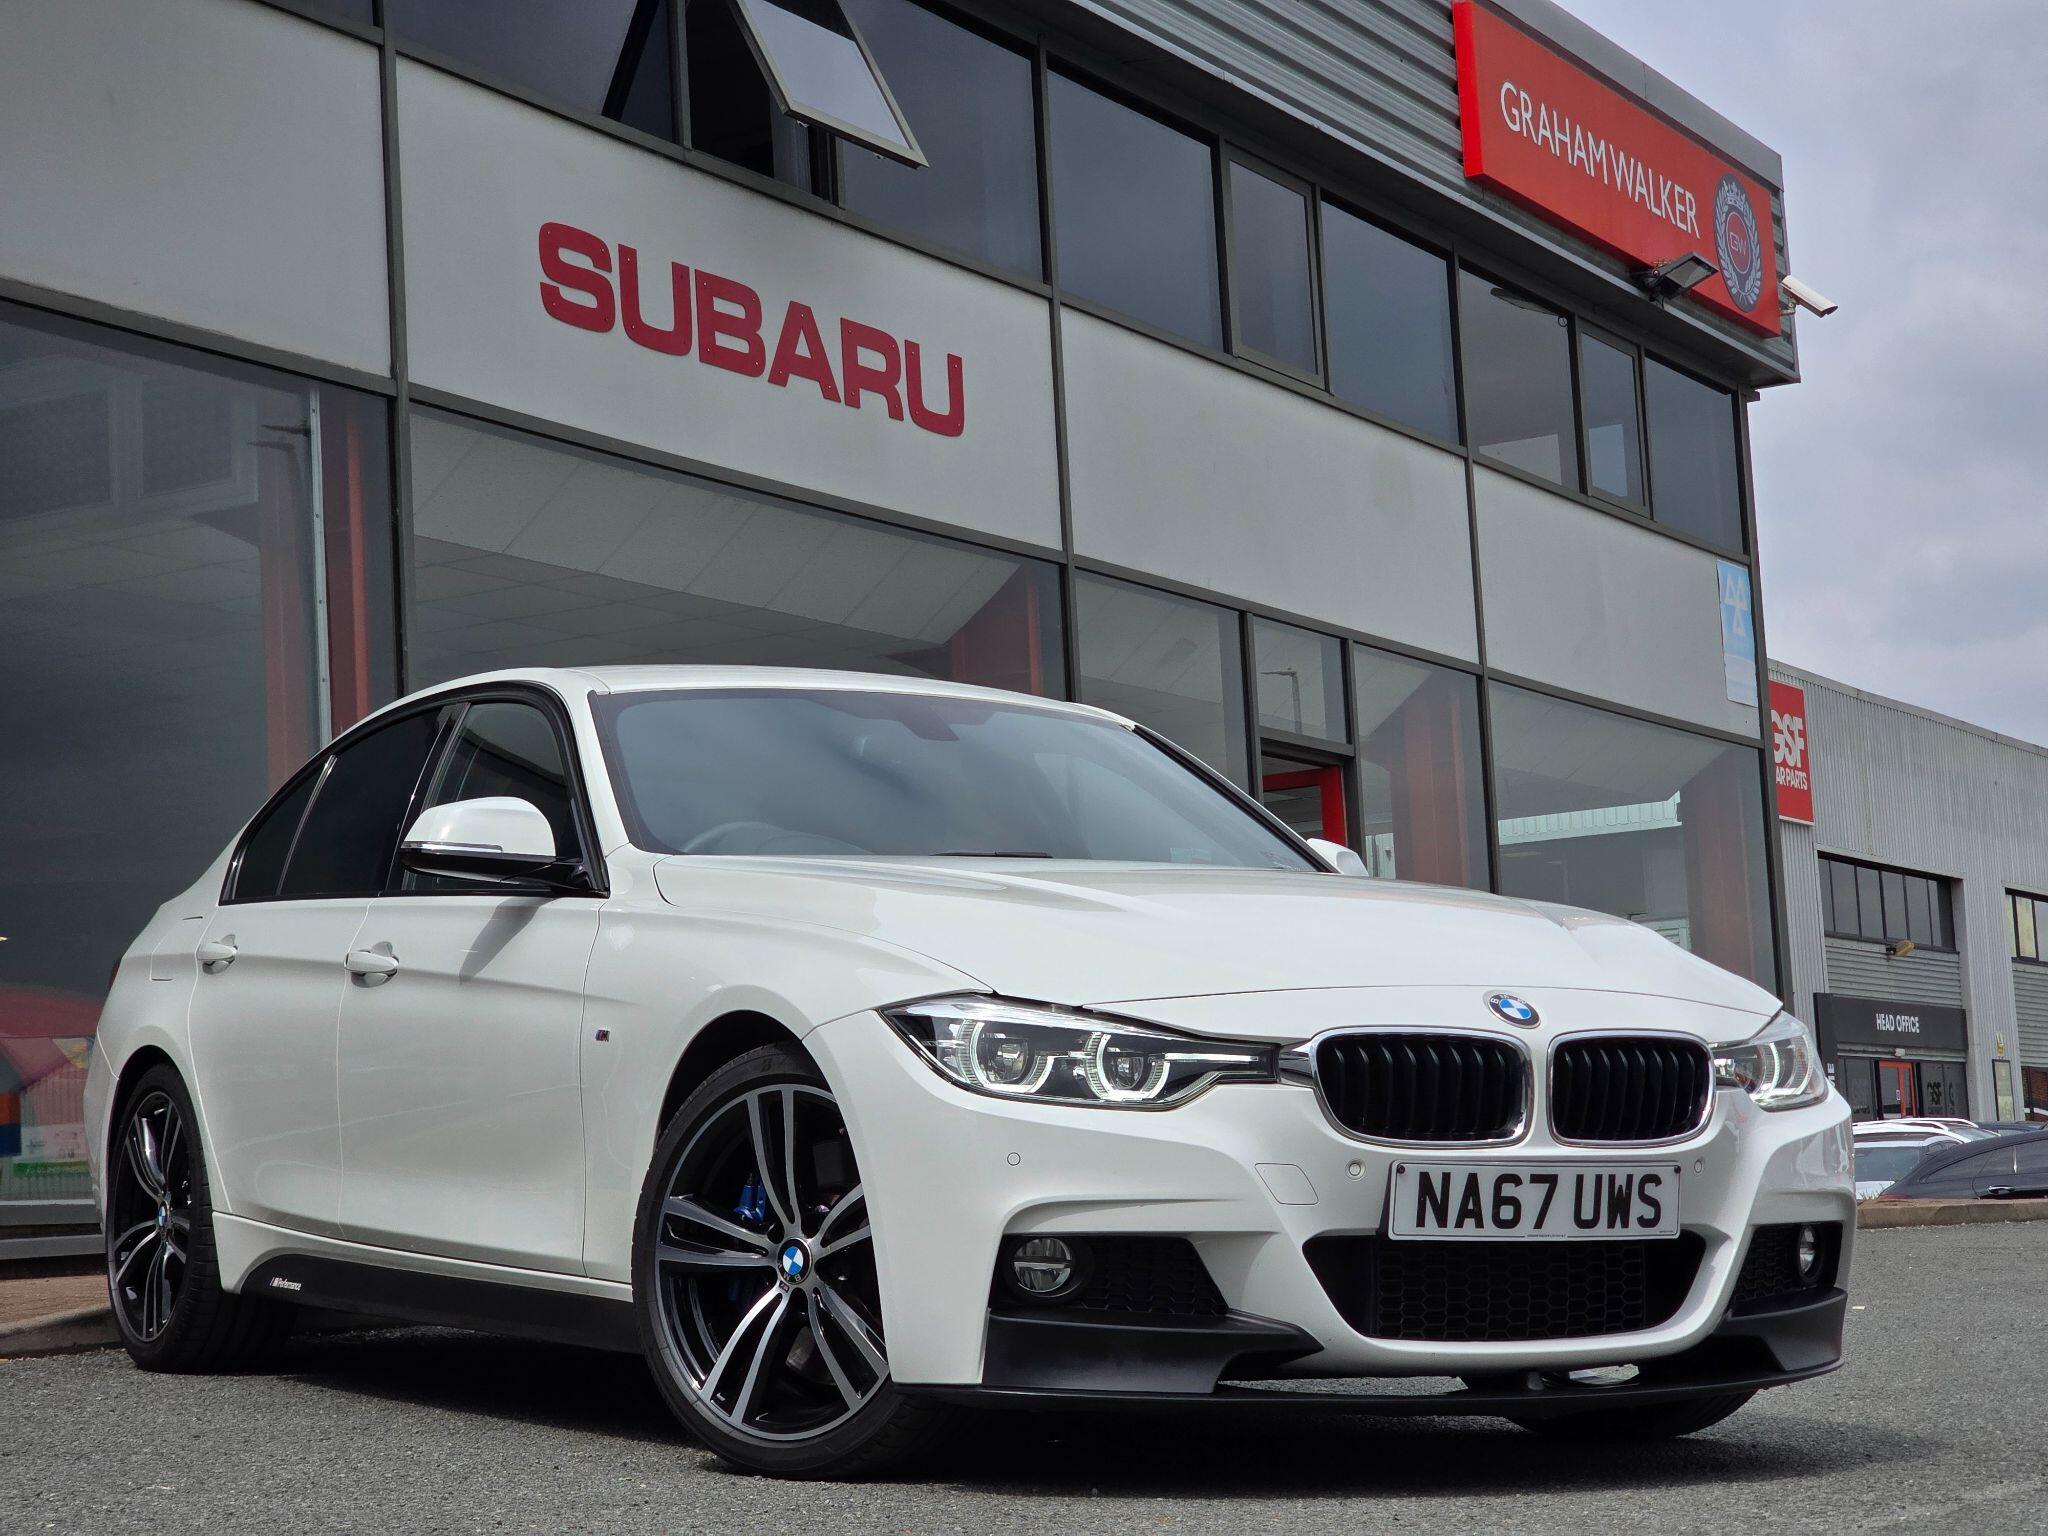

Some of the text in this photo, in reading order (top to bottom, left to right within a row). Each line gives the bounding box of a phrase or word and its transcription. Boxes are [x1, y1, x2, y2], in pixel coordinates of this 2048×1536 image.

[1500, 81, 1701, 239] GRAHAM WALKER
[538, 221, 965, 437] SUBARU
[1775, 765, 1808, 790] AR PARTS
[1876, 1013, 1920, 1033] HEAD OFFICE
[1416, 1171, 1662, 1230] NA67 UWS
